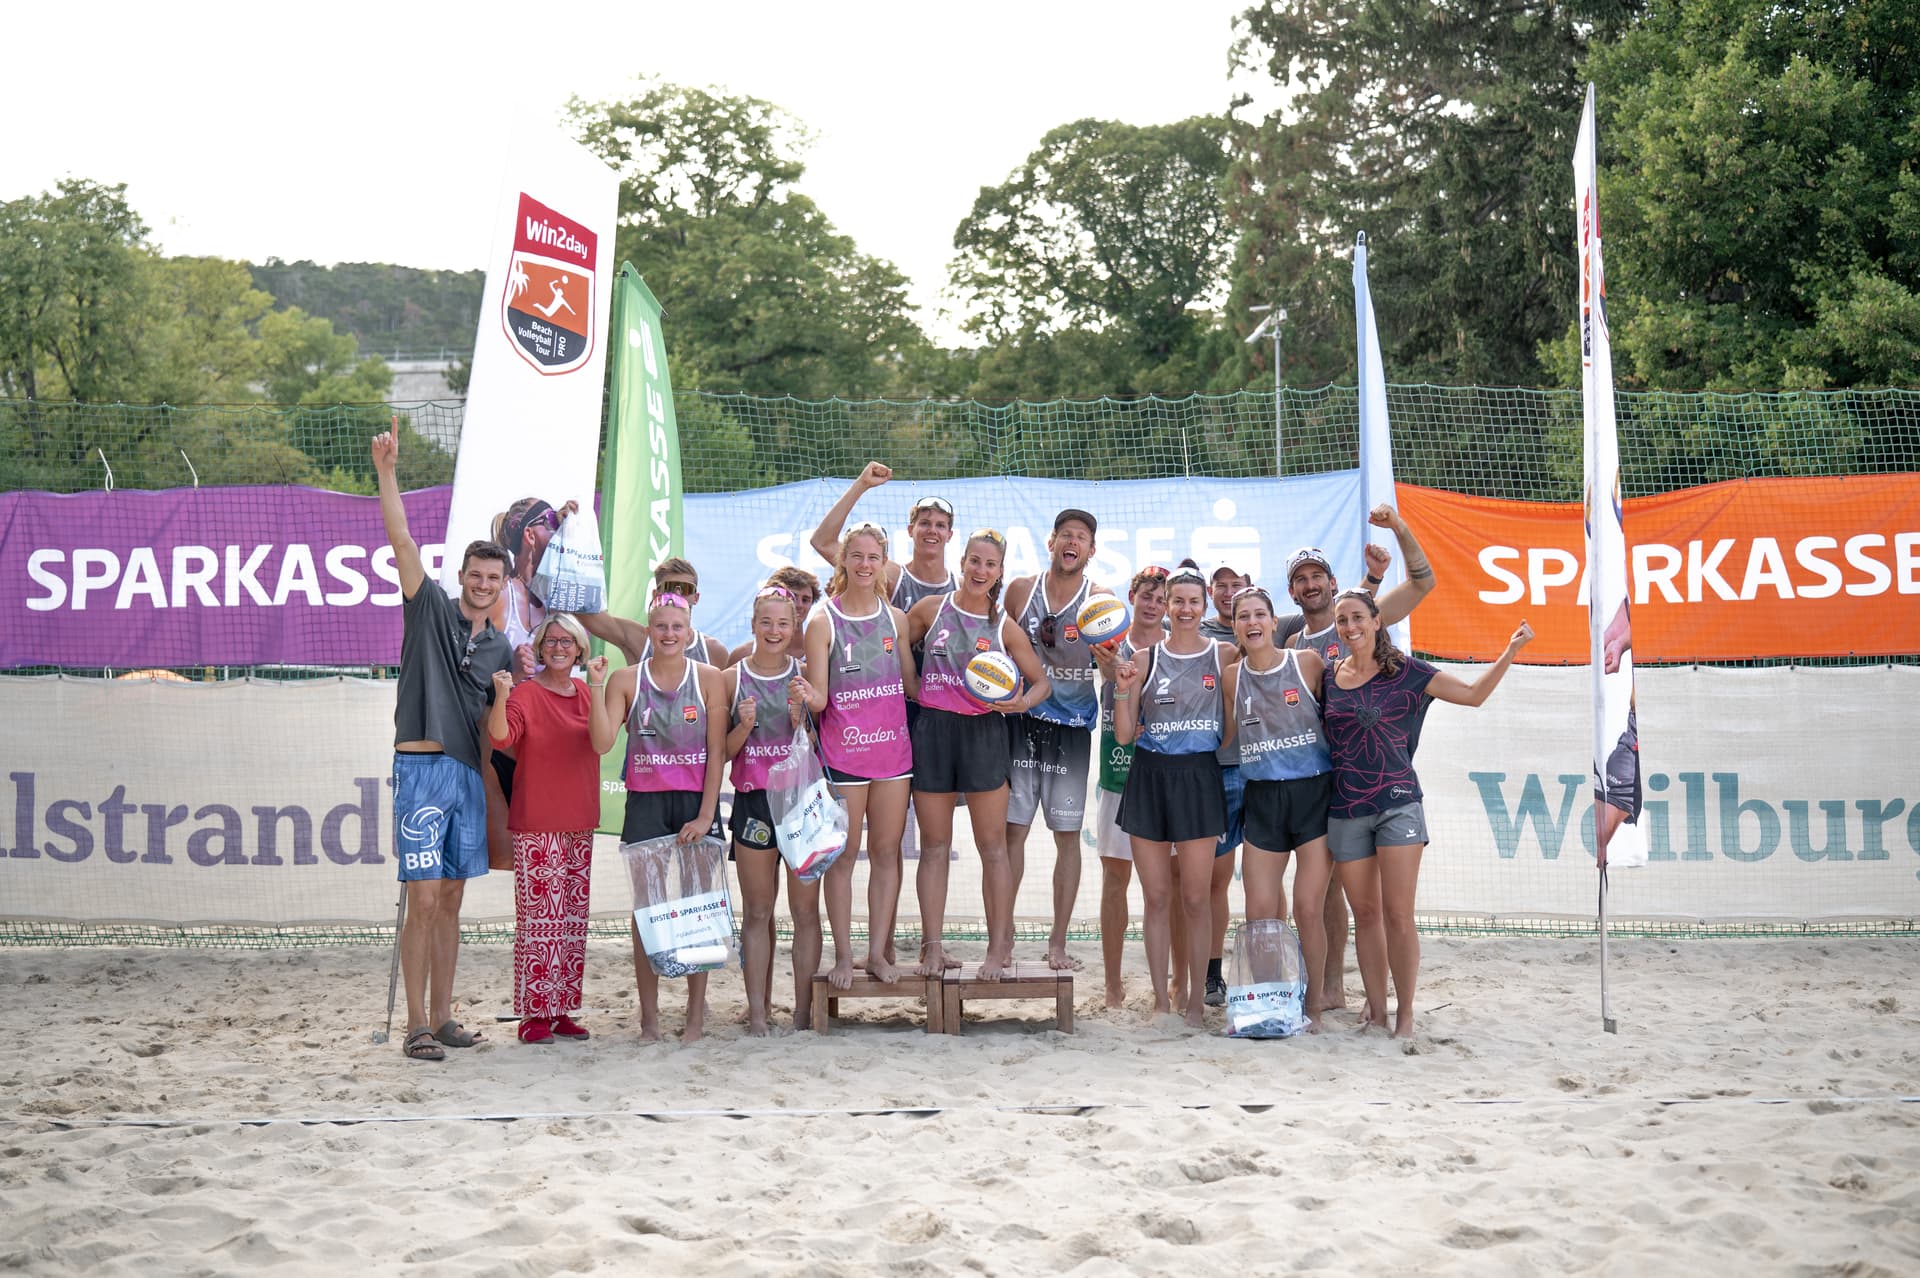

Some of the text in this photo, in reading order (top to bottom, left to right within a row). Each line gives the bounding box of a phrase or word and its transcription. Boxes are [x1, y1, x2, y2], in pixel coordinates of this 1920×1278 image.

[526, 216, 588, 259] Win2day
[518, 326, 552, 346] Volleyball
[532, 321, 552, 336] Beach
[536, 343, 550, 356] Tour
[558, 336, 566, 357] PRO
[933, 629, 949, 647] 2
[844, 643, 852, 662] 1
[836, 684, 897, 703] SPARKASSE
[1156, 677, 1171, 695] 2
[837, 701, 860, 711] Baden
[1244, 696, 1252, 715] 1
[642, 707, 651, 726] 1
[841, 726, 897, 745] Baden
[1150, 719, 1212, 734] SPARKASSE
[1240, 734, 1307, 755] SPARKASSE
[633, 752, 697, 765] SPARKASSE
[1241, 754, 1261, 764] Baden
[0, 772, 399, 867] lstrand
[649, 903, 719, 924] ERSTE SPARKASSE
